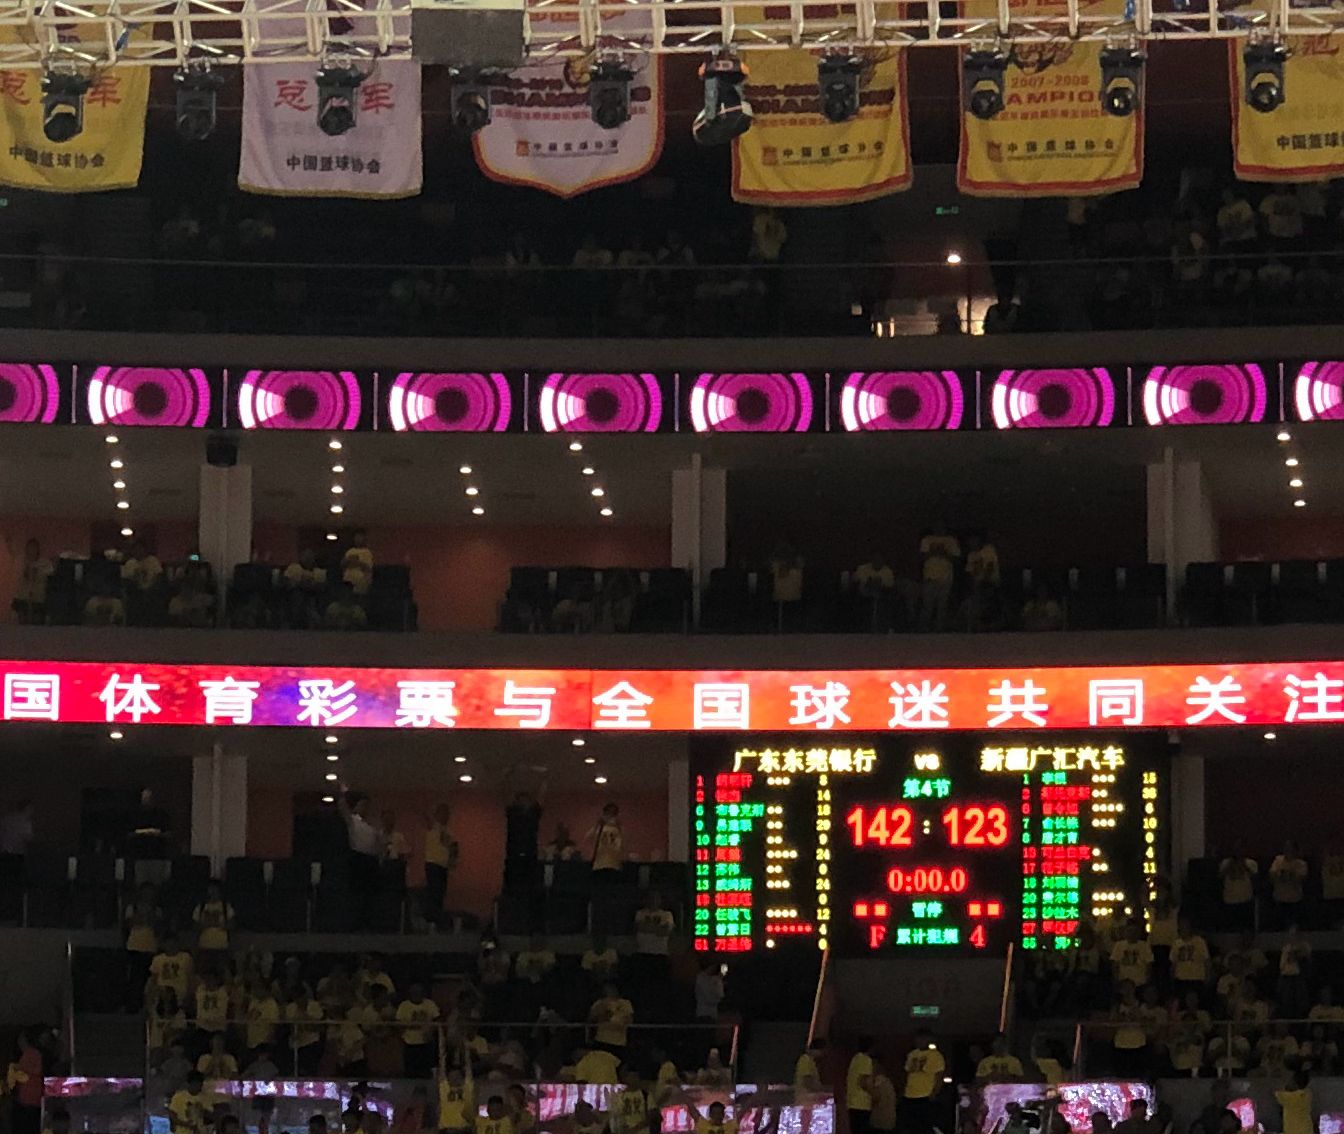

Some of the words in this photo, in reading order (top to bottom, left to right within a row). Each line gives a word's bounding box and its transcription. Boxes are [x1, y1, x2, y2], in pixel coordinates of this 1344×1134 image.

[274, 79, 395, 113] 总军
[1006, 90, 1095, 105] AMPIO
[9, 143, 106, 169] 中国篮球协会
[286, 154, 380, 174] 中国篮球协会
[733, 748, 877, 772] 广东东莞银行
[980, 747, 1125, 772] 新疆广汇汽车
[902, 778, 952, 799] 第4节
[847, 806, 913, 846] 142
[943, 806, 1009, 846] 123
[887, 867, 967, 893] 0:00.0
[911, 901, 944, 919] 暂停
[895, 927, 960, 945] 累计犯规
